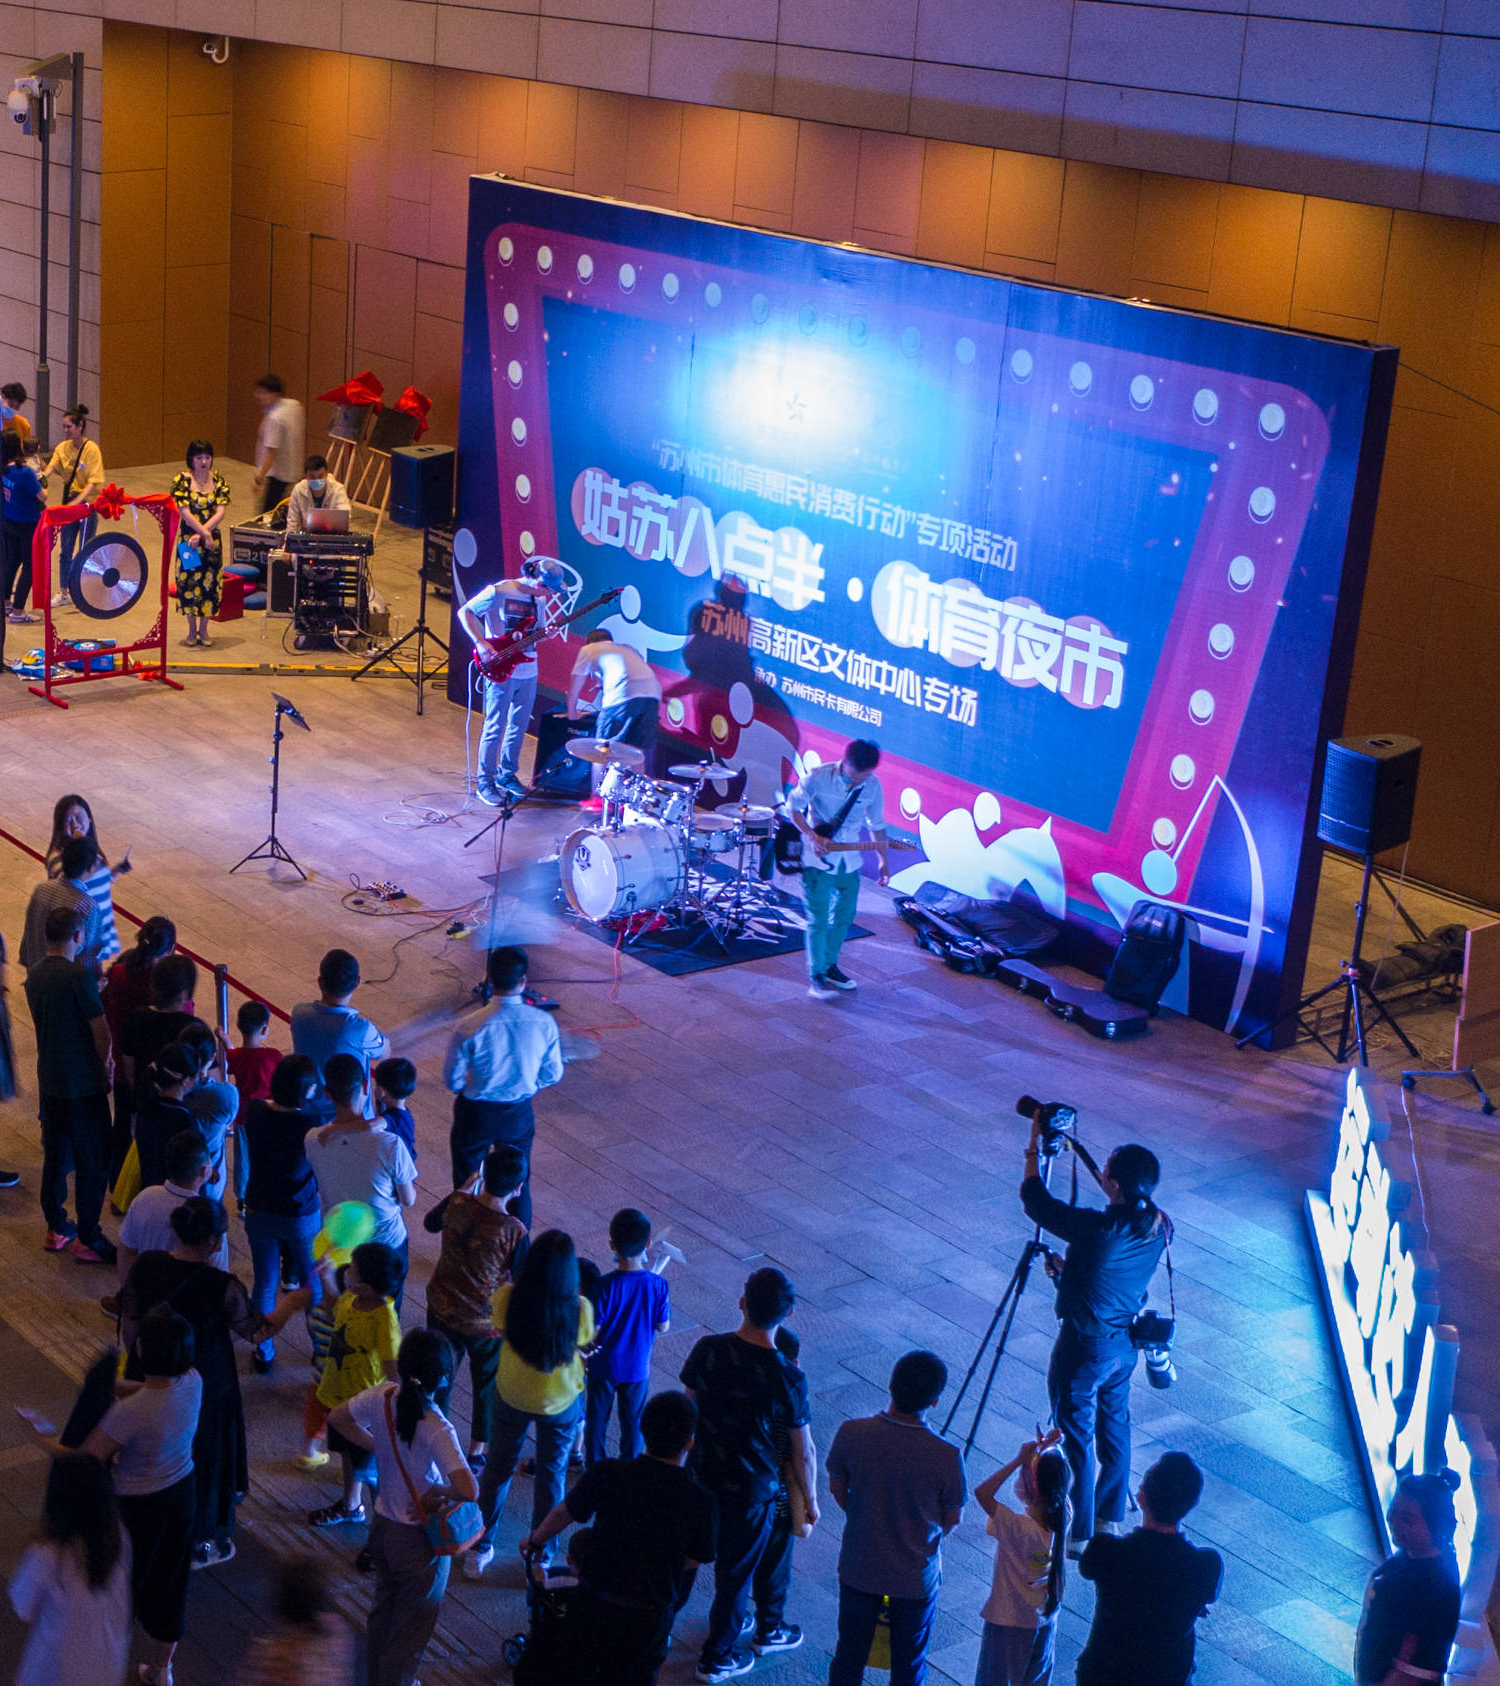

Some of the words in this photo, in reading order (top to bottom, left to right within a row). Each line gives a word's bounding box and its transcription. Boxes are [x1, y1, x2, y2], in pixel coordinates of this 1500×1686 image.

[700, 599, 979, 728] 苏州高新区文体中心专场
[780, 676, 883, 727] 苏州市民卡有限公司
